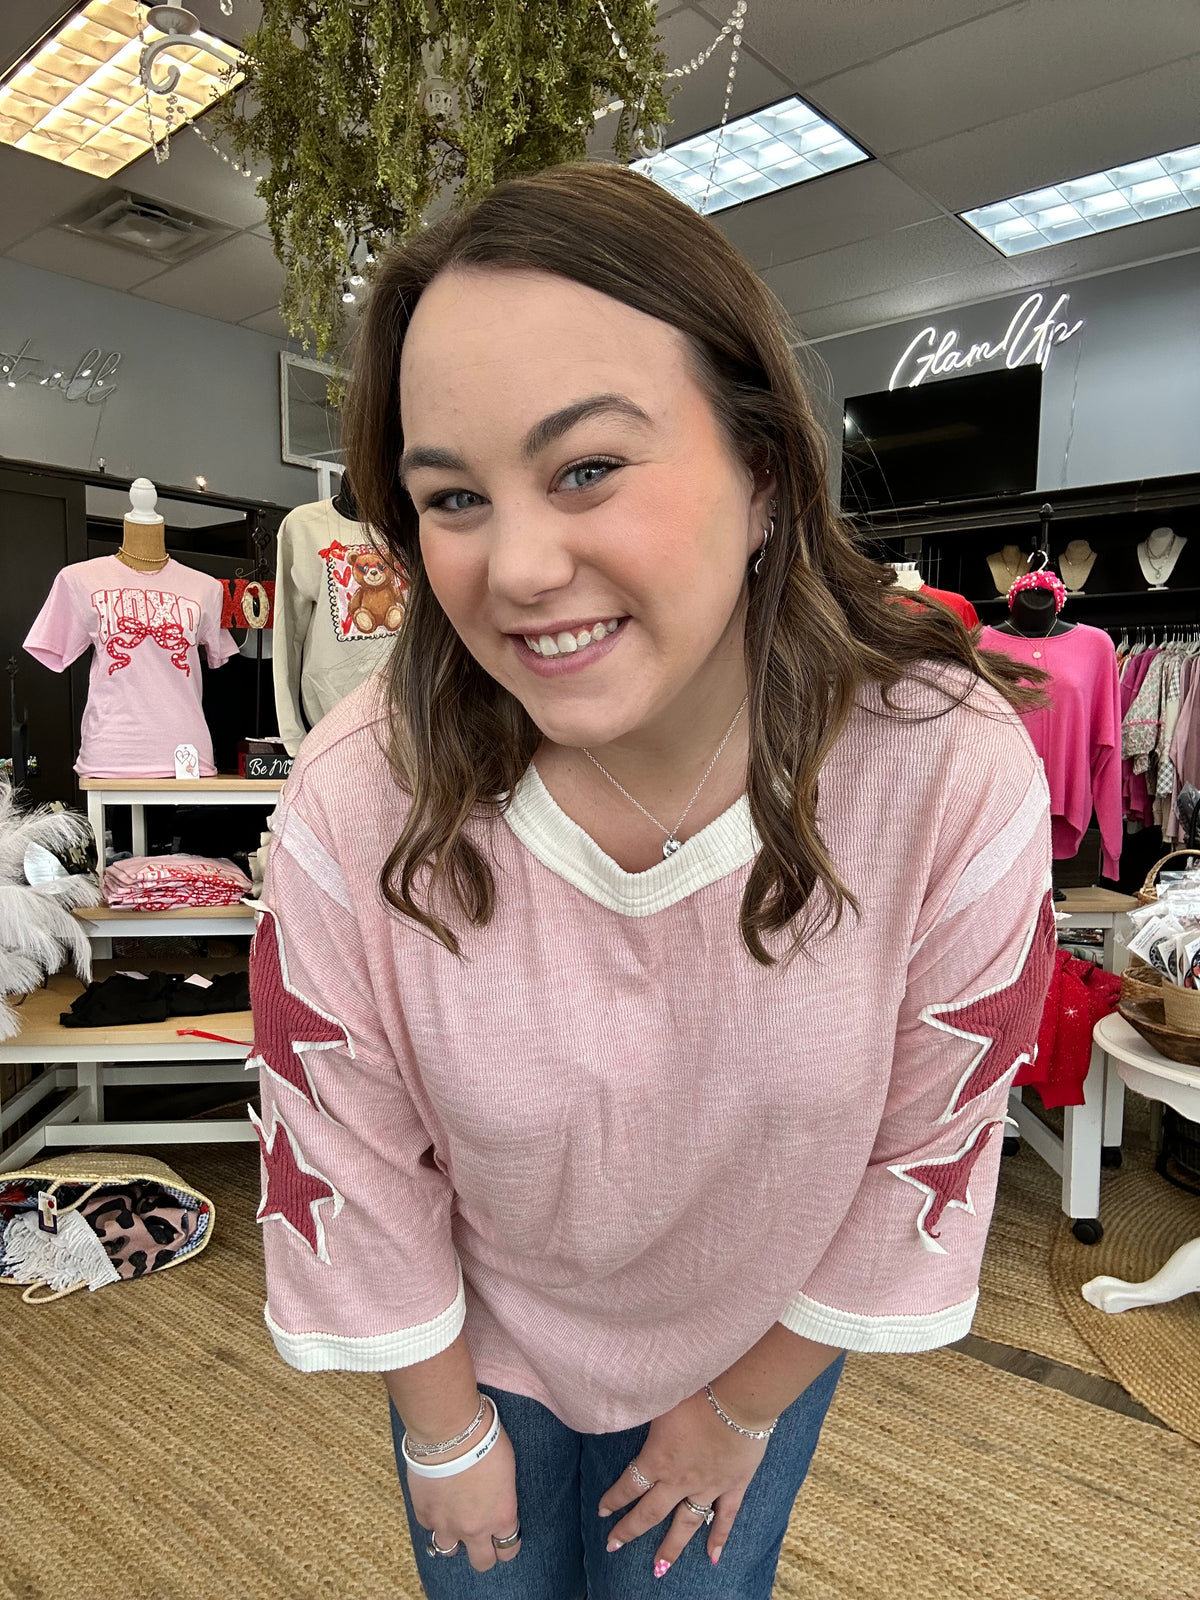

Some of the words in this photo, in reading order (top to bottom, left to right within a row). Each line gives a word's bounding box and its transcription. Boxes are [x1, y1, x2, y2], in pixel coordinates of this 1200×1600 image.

[888, 326, 1003, 392] Glam
[1003, 292, 1084, 372] Up
[46, 348, 121, 403] all
[91, 588, 201, 646] XOXO
[249, 758, 268, 776] Be
